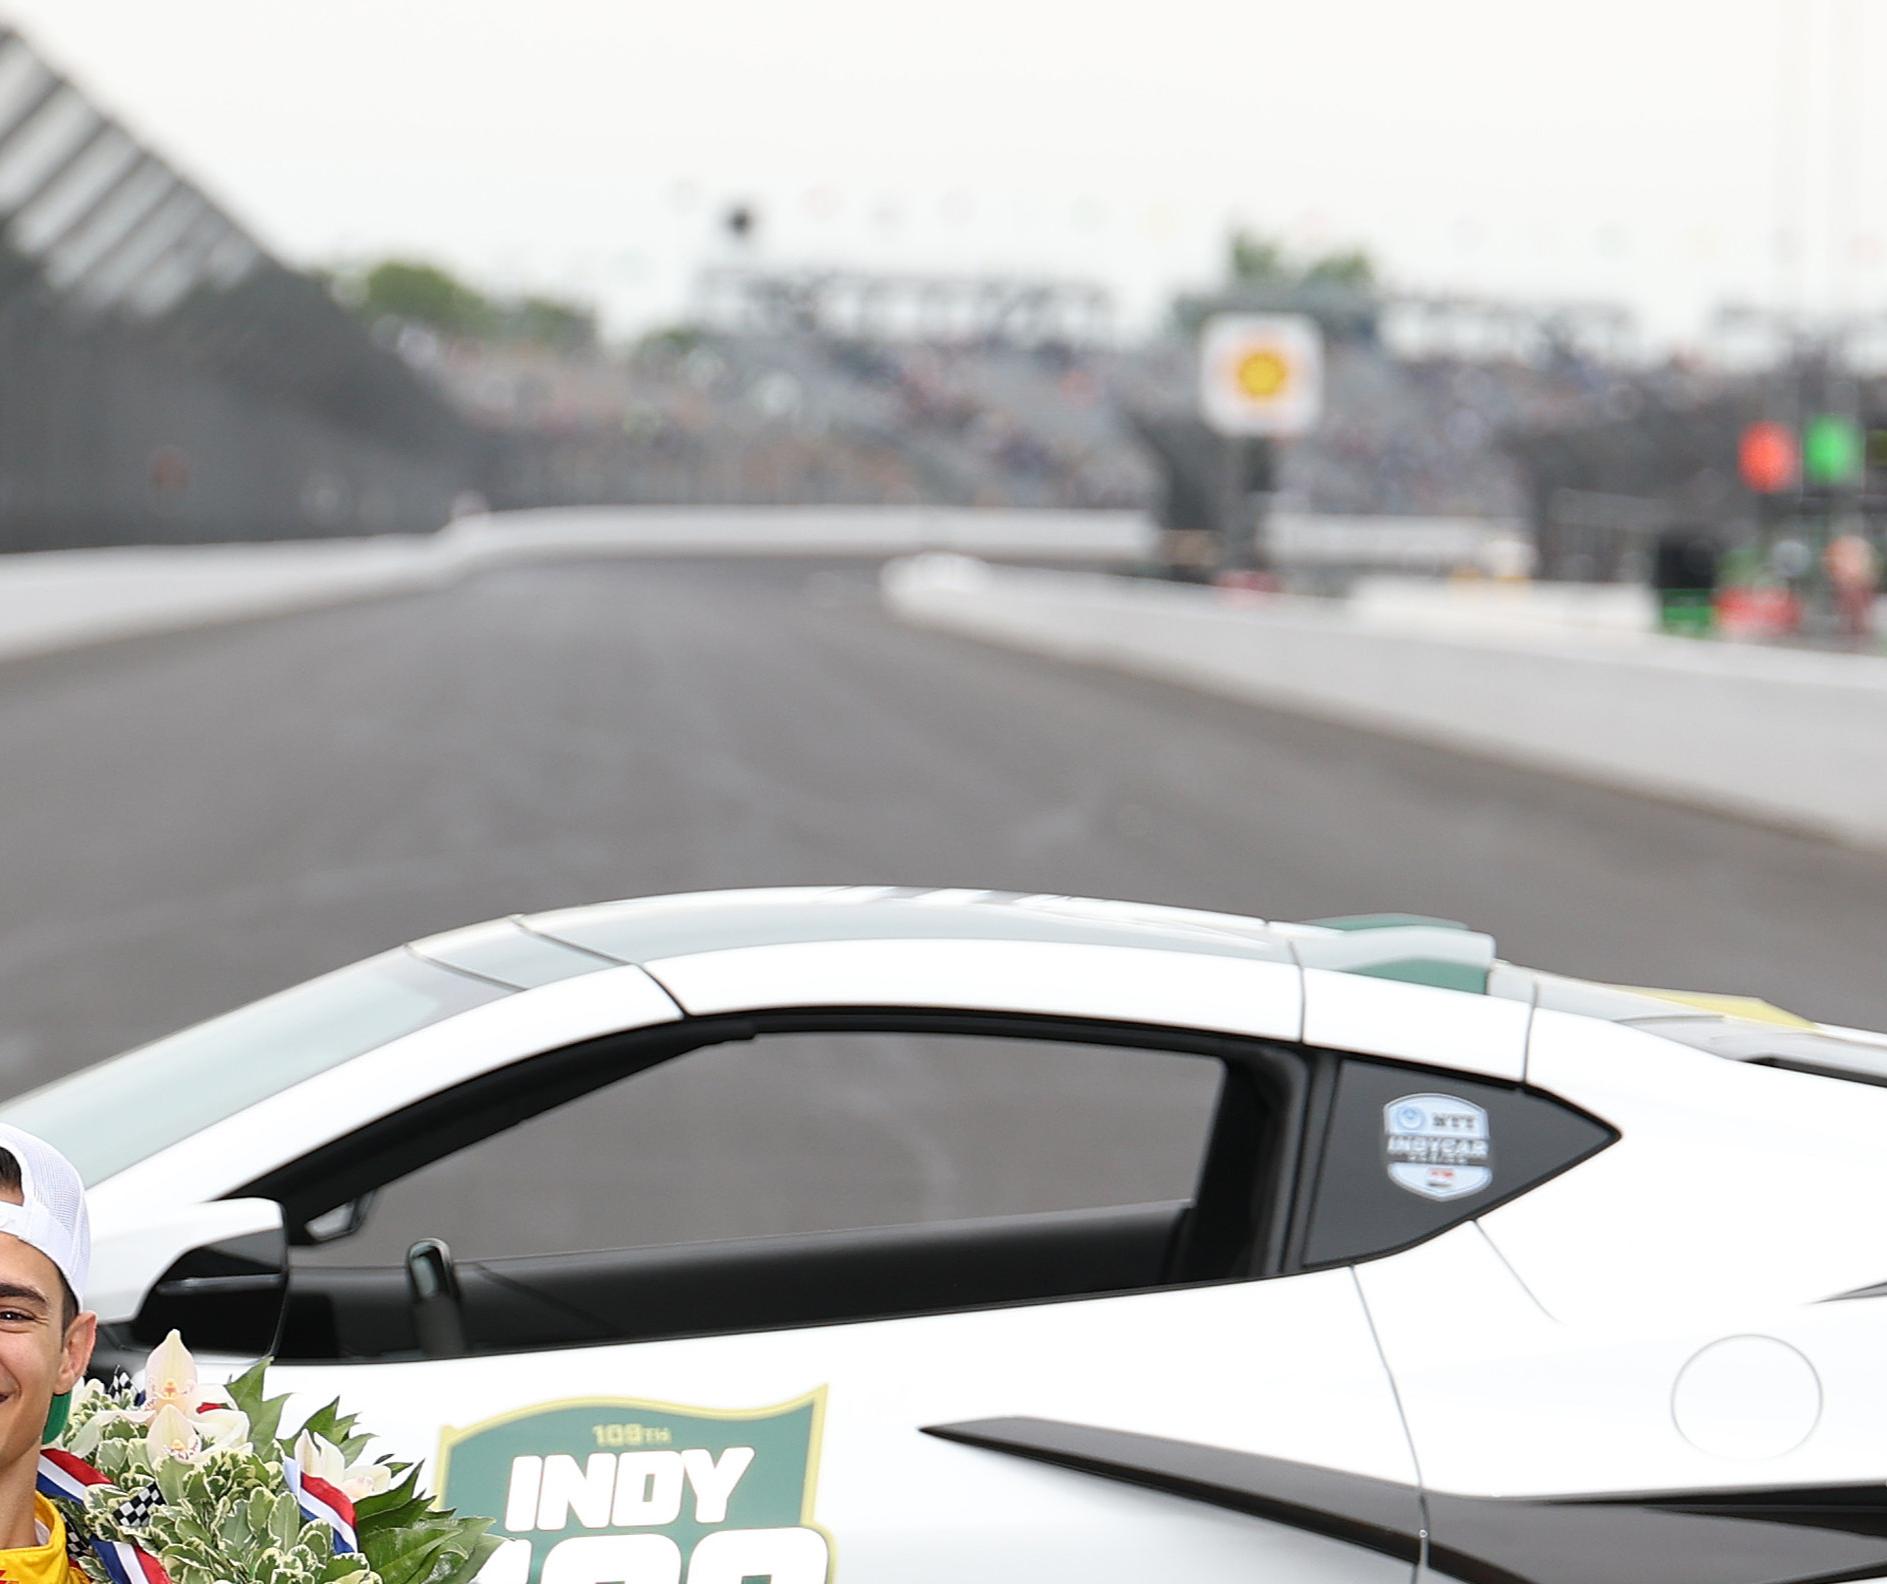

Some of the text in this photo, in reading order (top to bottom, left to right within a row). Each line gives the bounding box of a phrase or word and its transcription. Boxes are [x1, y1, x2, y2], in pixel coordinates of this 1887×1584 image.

[1431, 1112, 1476, 1129] NTT
[1387, 1135, 1489, 1157] INDYCAR
[592, 1423, 671, 1447] 109TH
[504, 1446, 755, 1532] INDY
